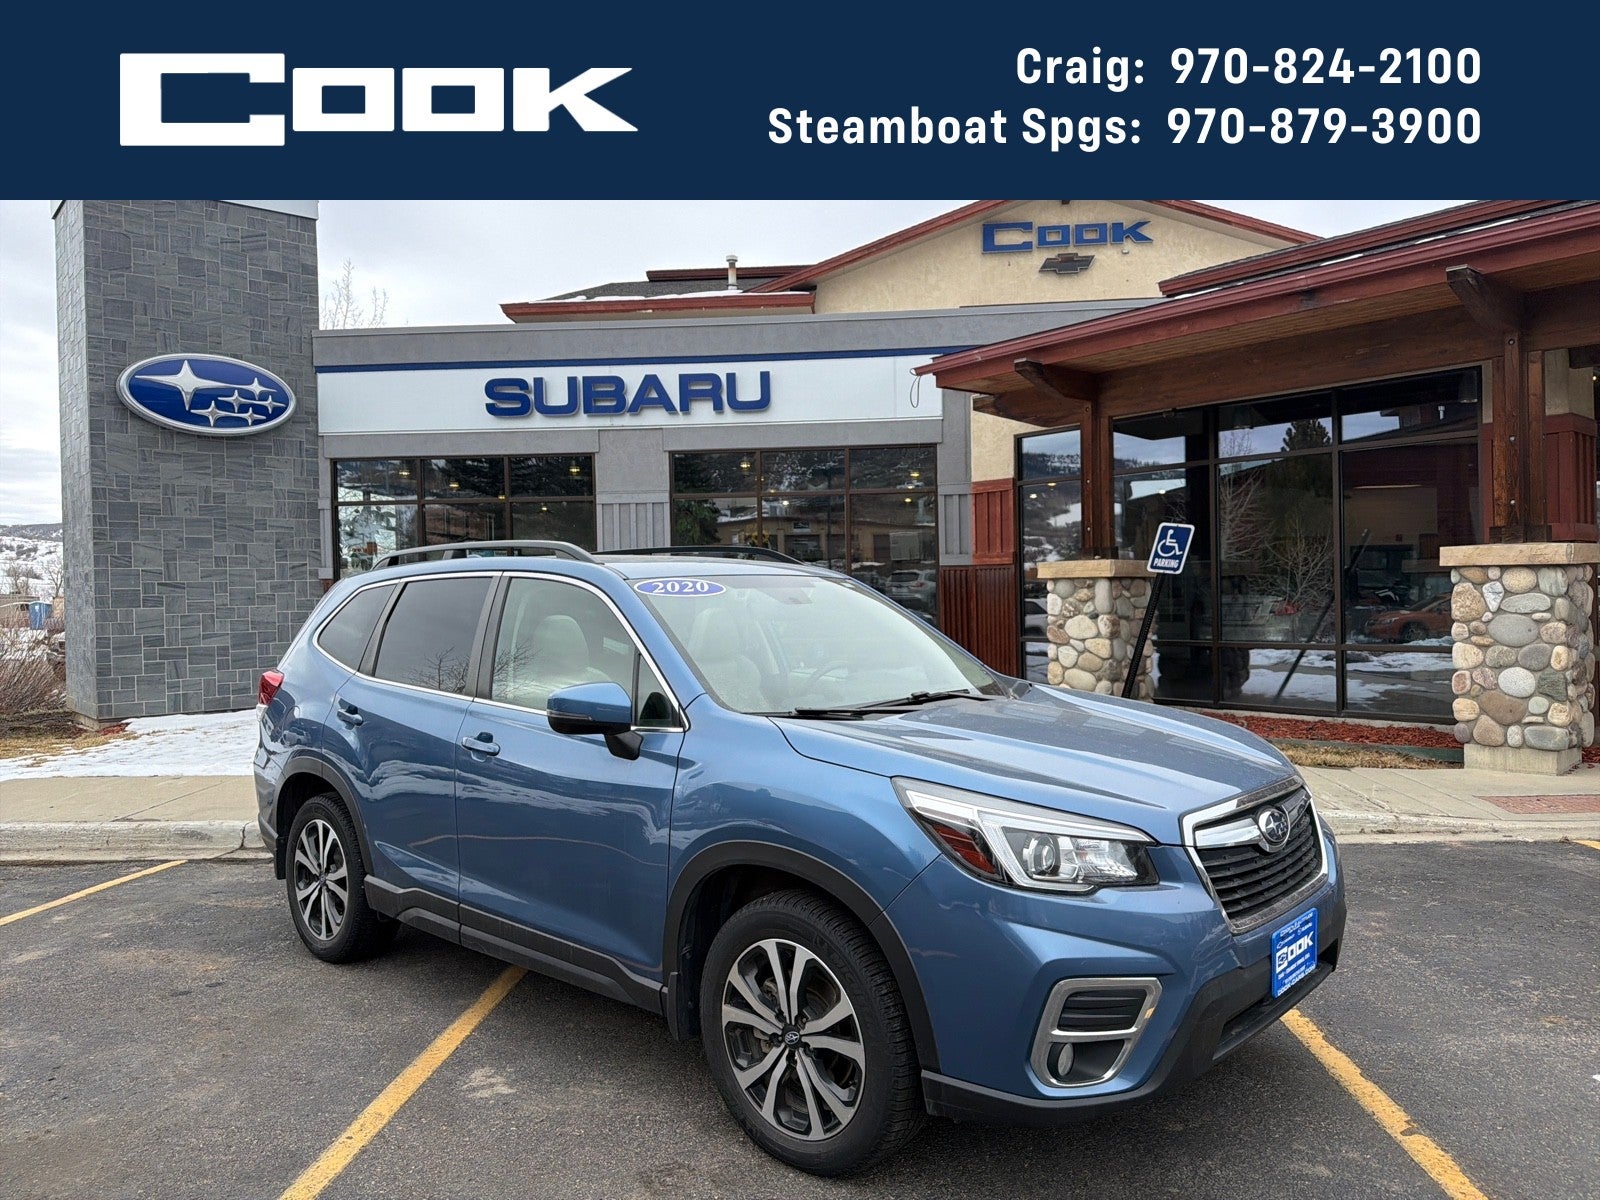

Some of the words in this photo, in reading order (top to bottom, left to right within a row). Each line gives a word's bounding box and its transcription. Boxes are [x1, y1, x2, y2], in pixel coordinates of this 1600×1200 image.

[485, 371, 771, 417] SUBARU
[1153, 557, 1179, 568] PARKING
[652, 581, 710, 593] 2020
